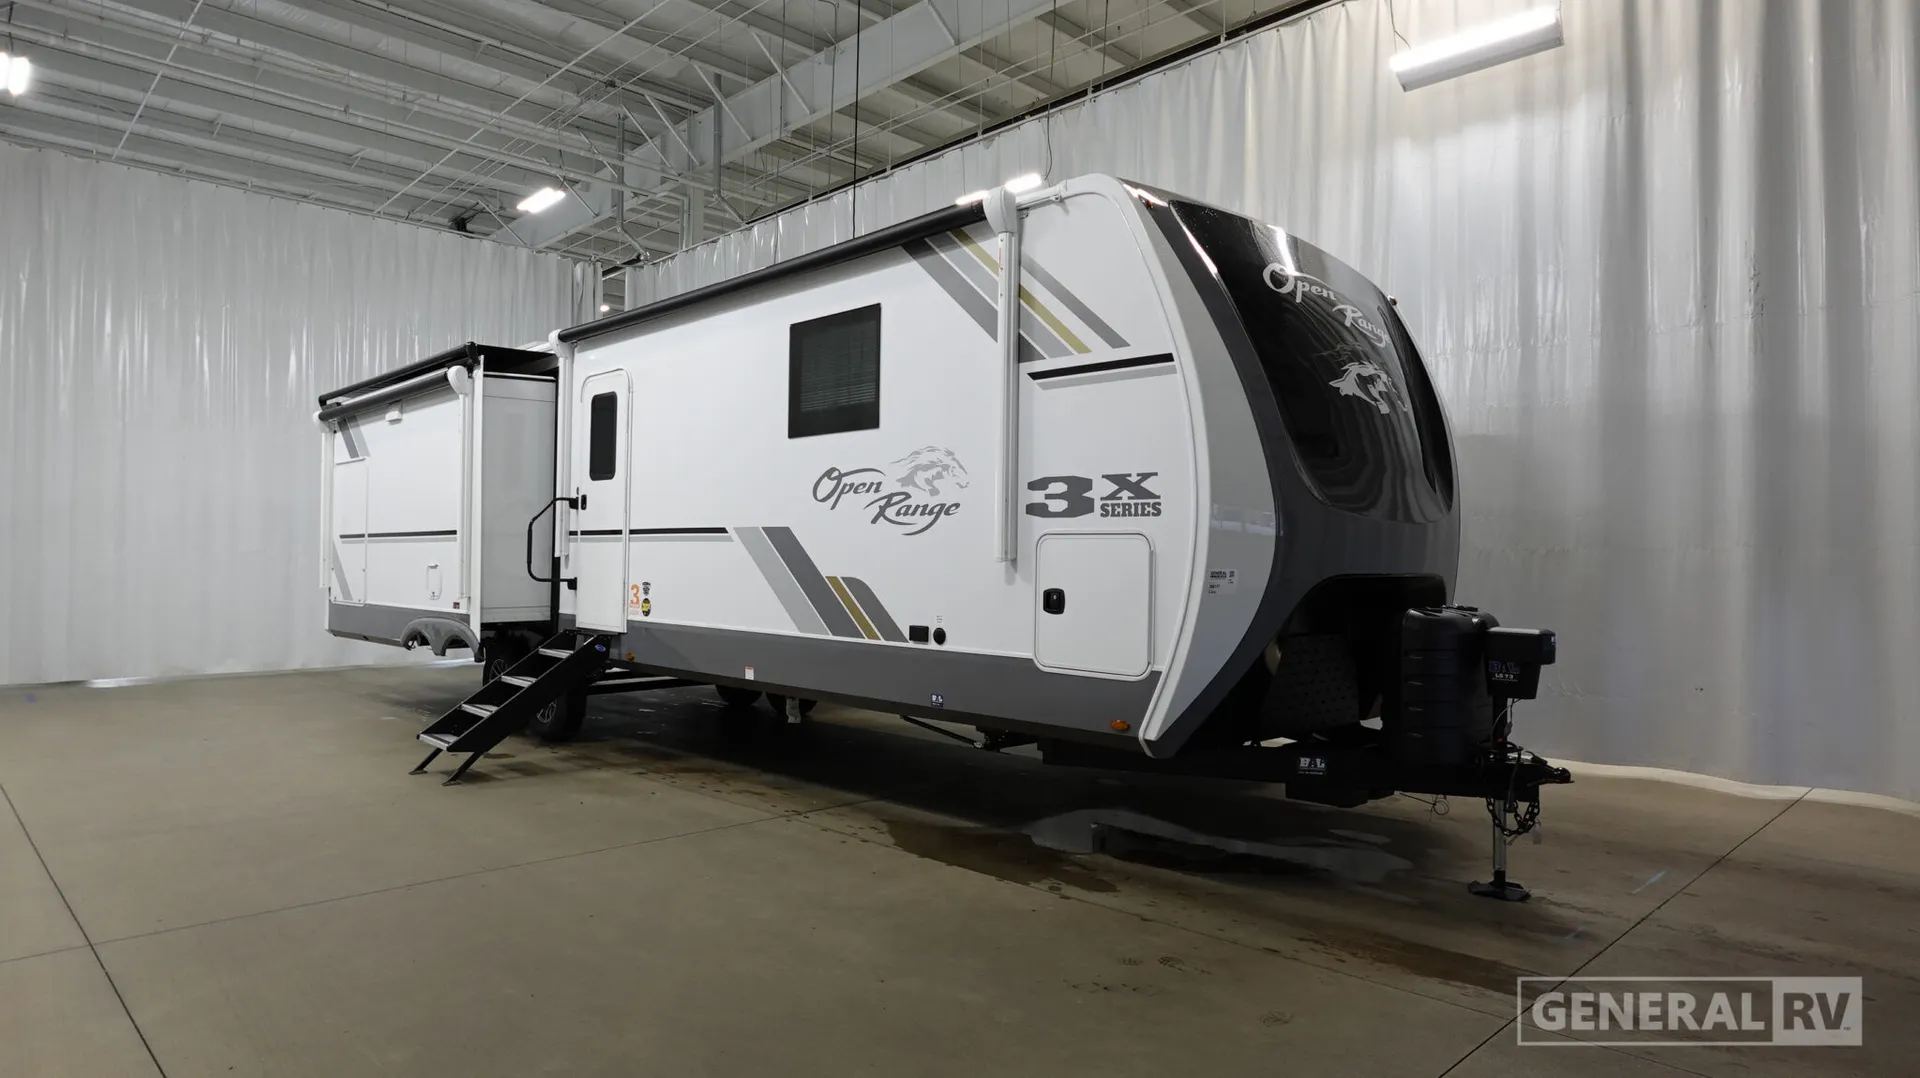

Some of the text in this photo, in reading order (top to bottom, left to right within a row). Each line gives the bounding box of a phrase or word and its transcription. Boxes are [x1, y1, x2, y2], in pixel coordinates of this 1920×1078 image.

[1262, 262, 1337, 303] Open
[1332, 304, 1391, 348] Range
[812, 466, 886, 511] Open
[1100, 501, 1162, 518] SERIES
[863, 491, 961, 536] Range
